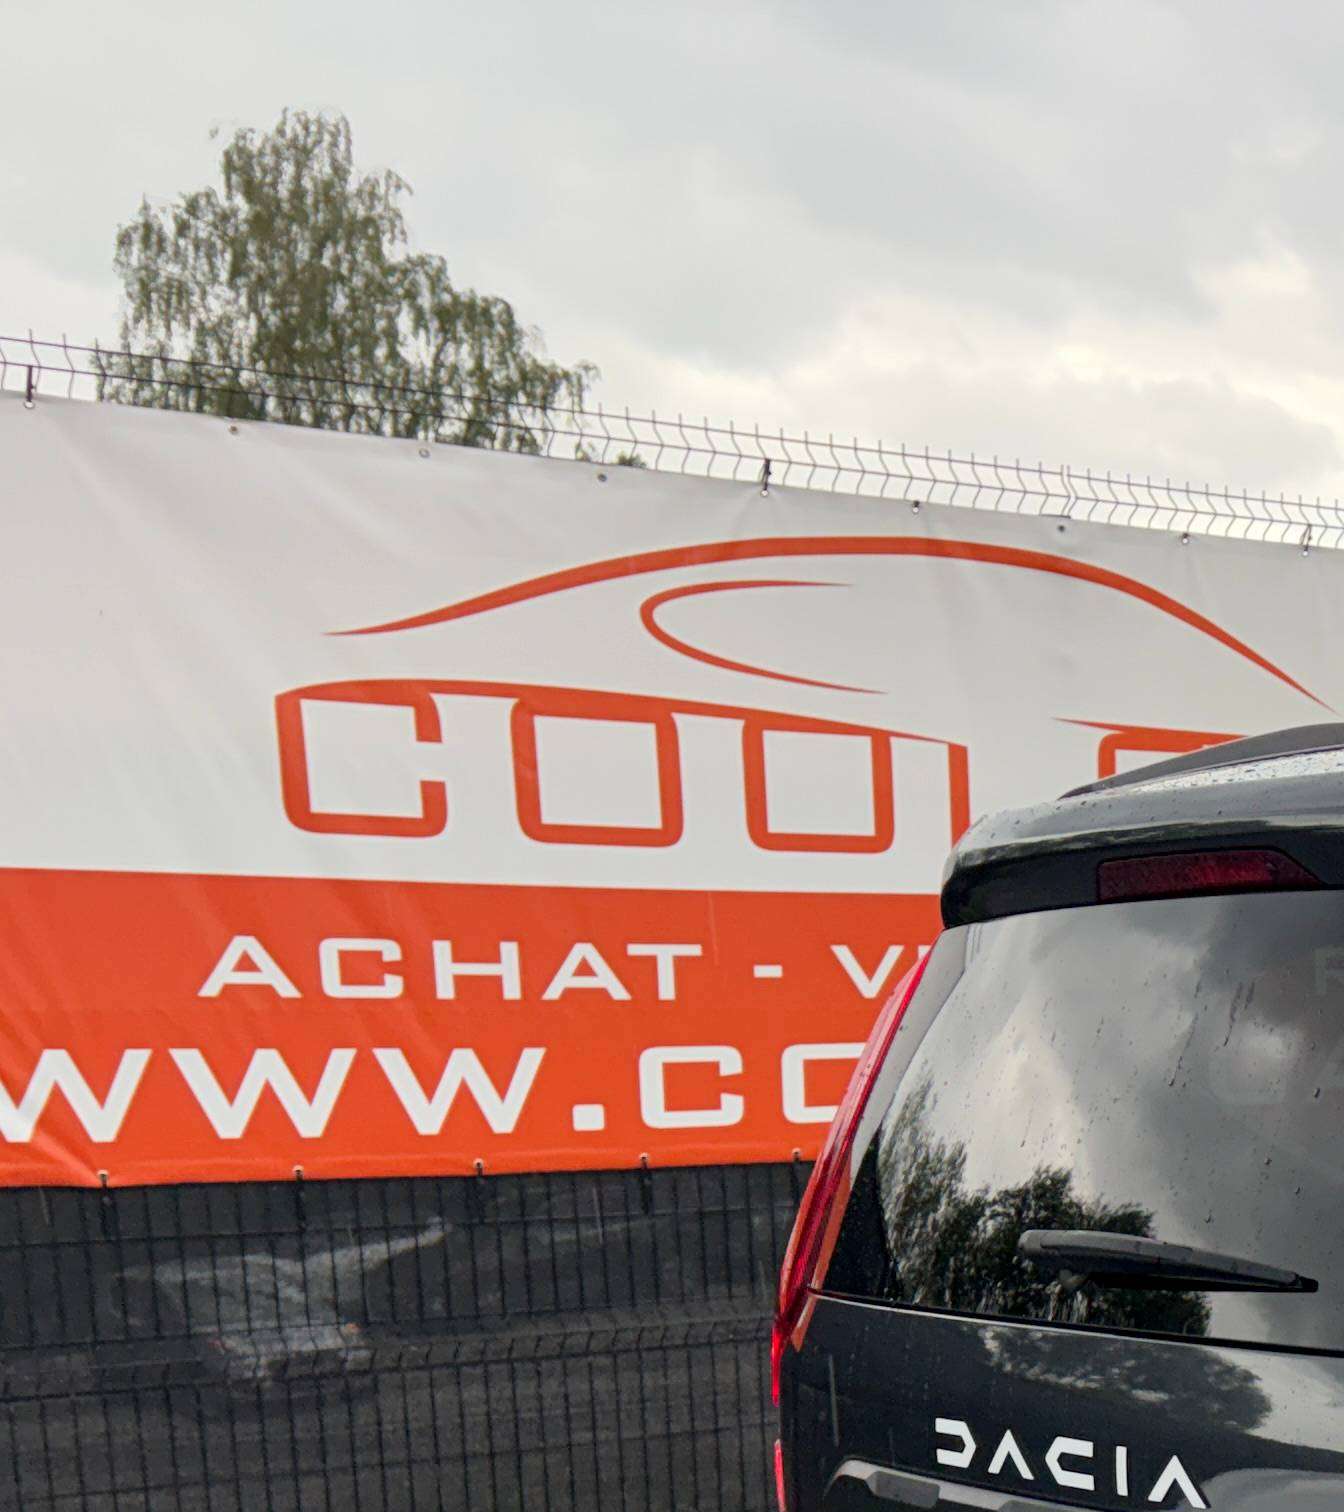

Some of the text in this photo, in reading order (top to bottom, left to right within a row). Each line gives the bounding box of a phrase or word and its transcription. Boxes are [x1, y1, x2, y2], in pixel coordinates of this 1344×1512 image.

[198, 934, 703, 1000] ACHAT
[830, 943, 932, 999] V
[935, 1417, 1207, 1509] DACIA
